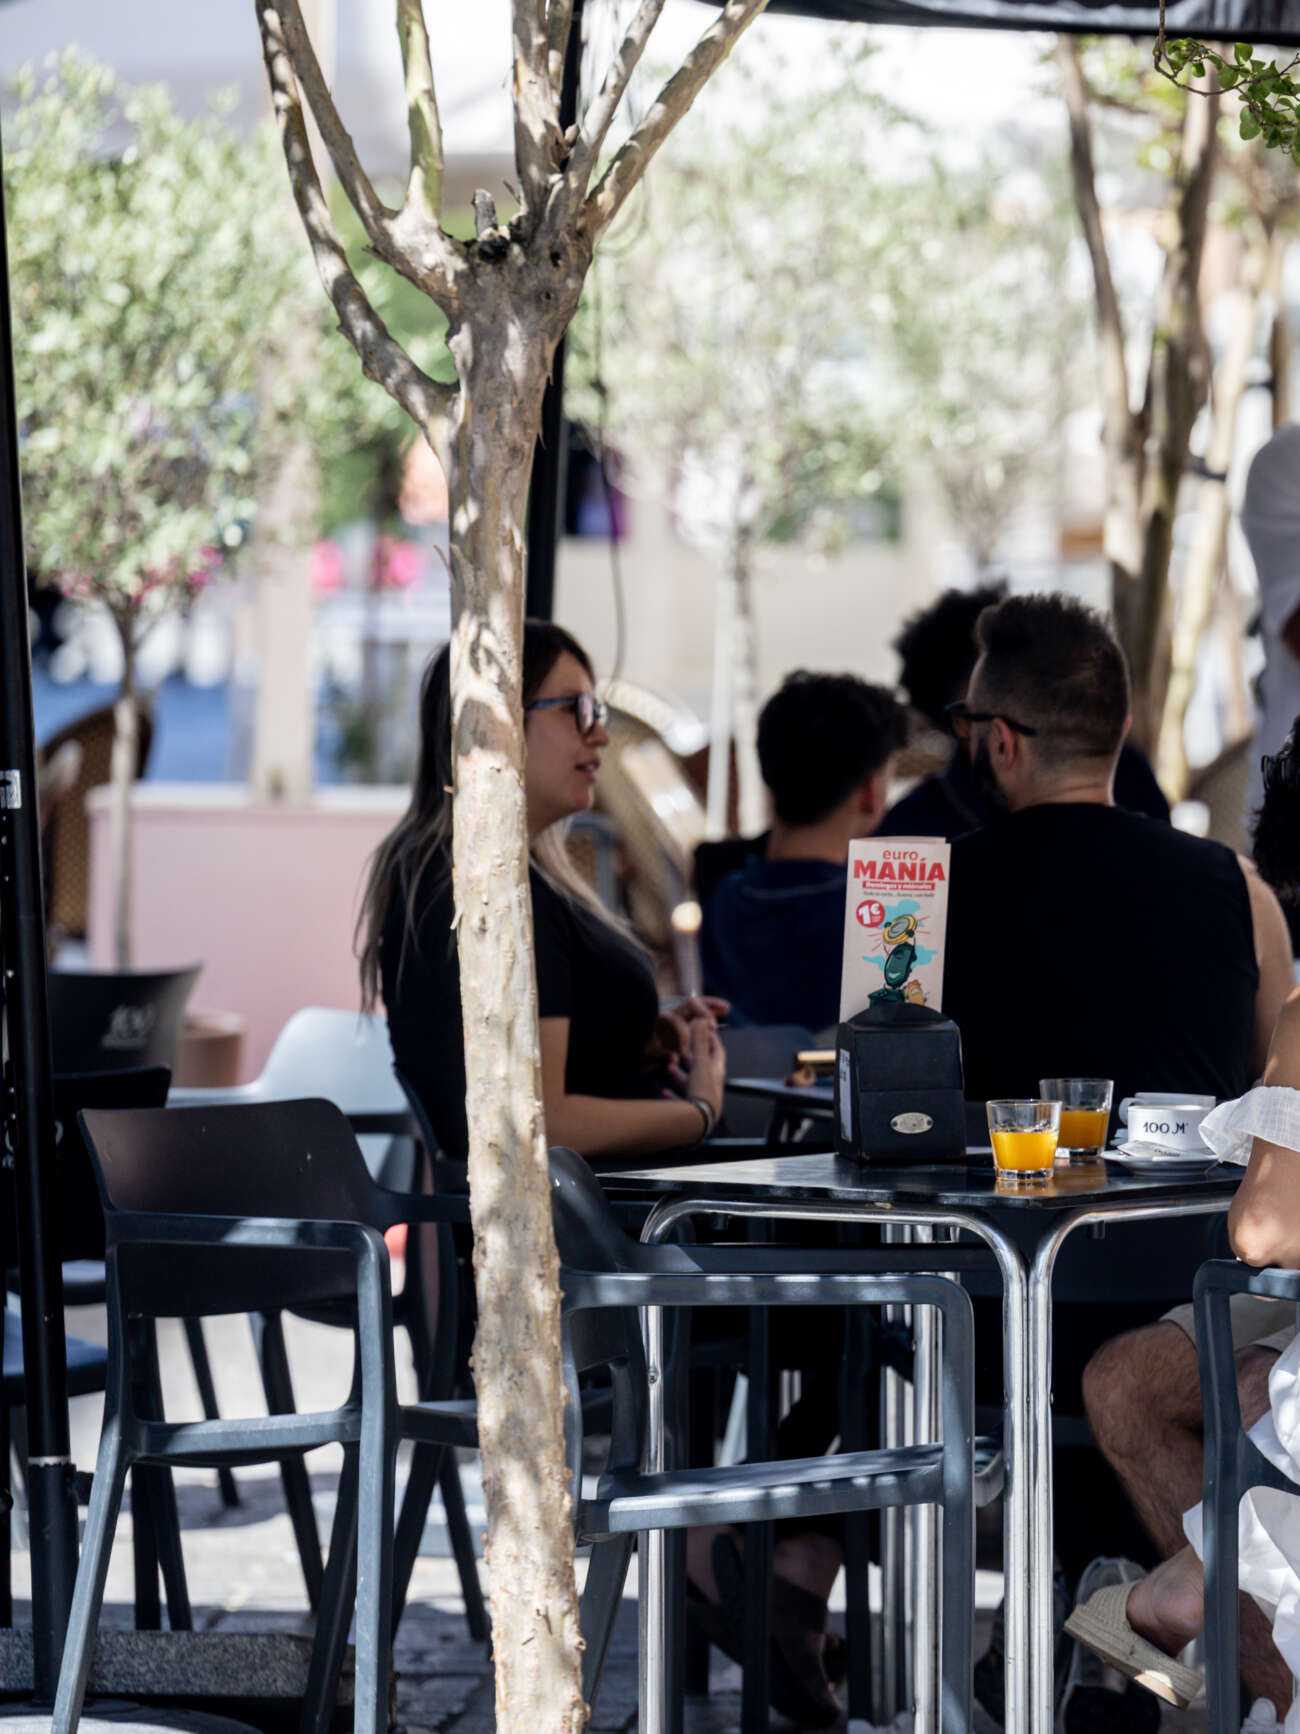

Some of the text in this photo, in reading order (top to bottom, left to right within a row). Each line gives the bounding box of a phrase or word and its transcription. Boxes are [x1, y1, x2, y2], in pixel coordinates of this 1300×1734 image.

[882, 849, 919, 861] euro
[853, 857, 945, 881] MANÍA
[859, 903, 880, 924] 1€
[1143, 1122, 1170, 1134] 100
